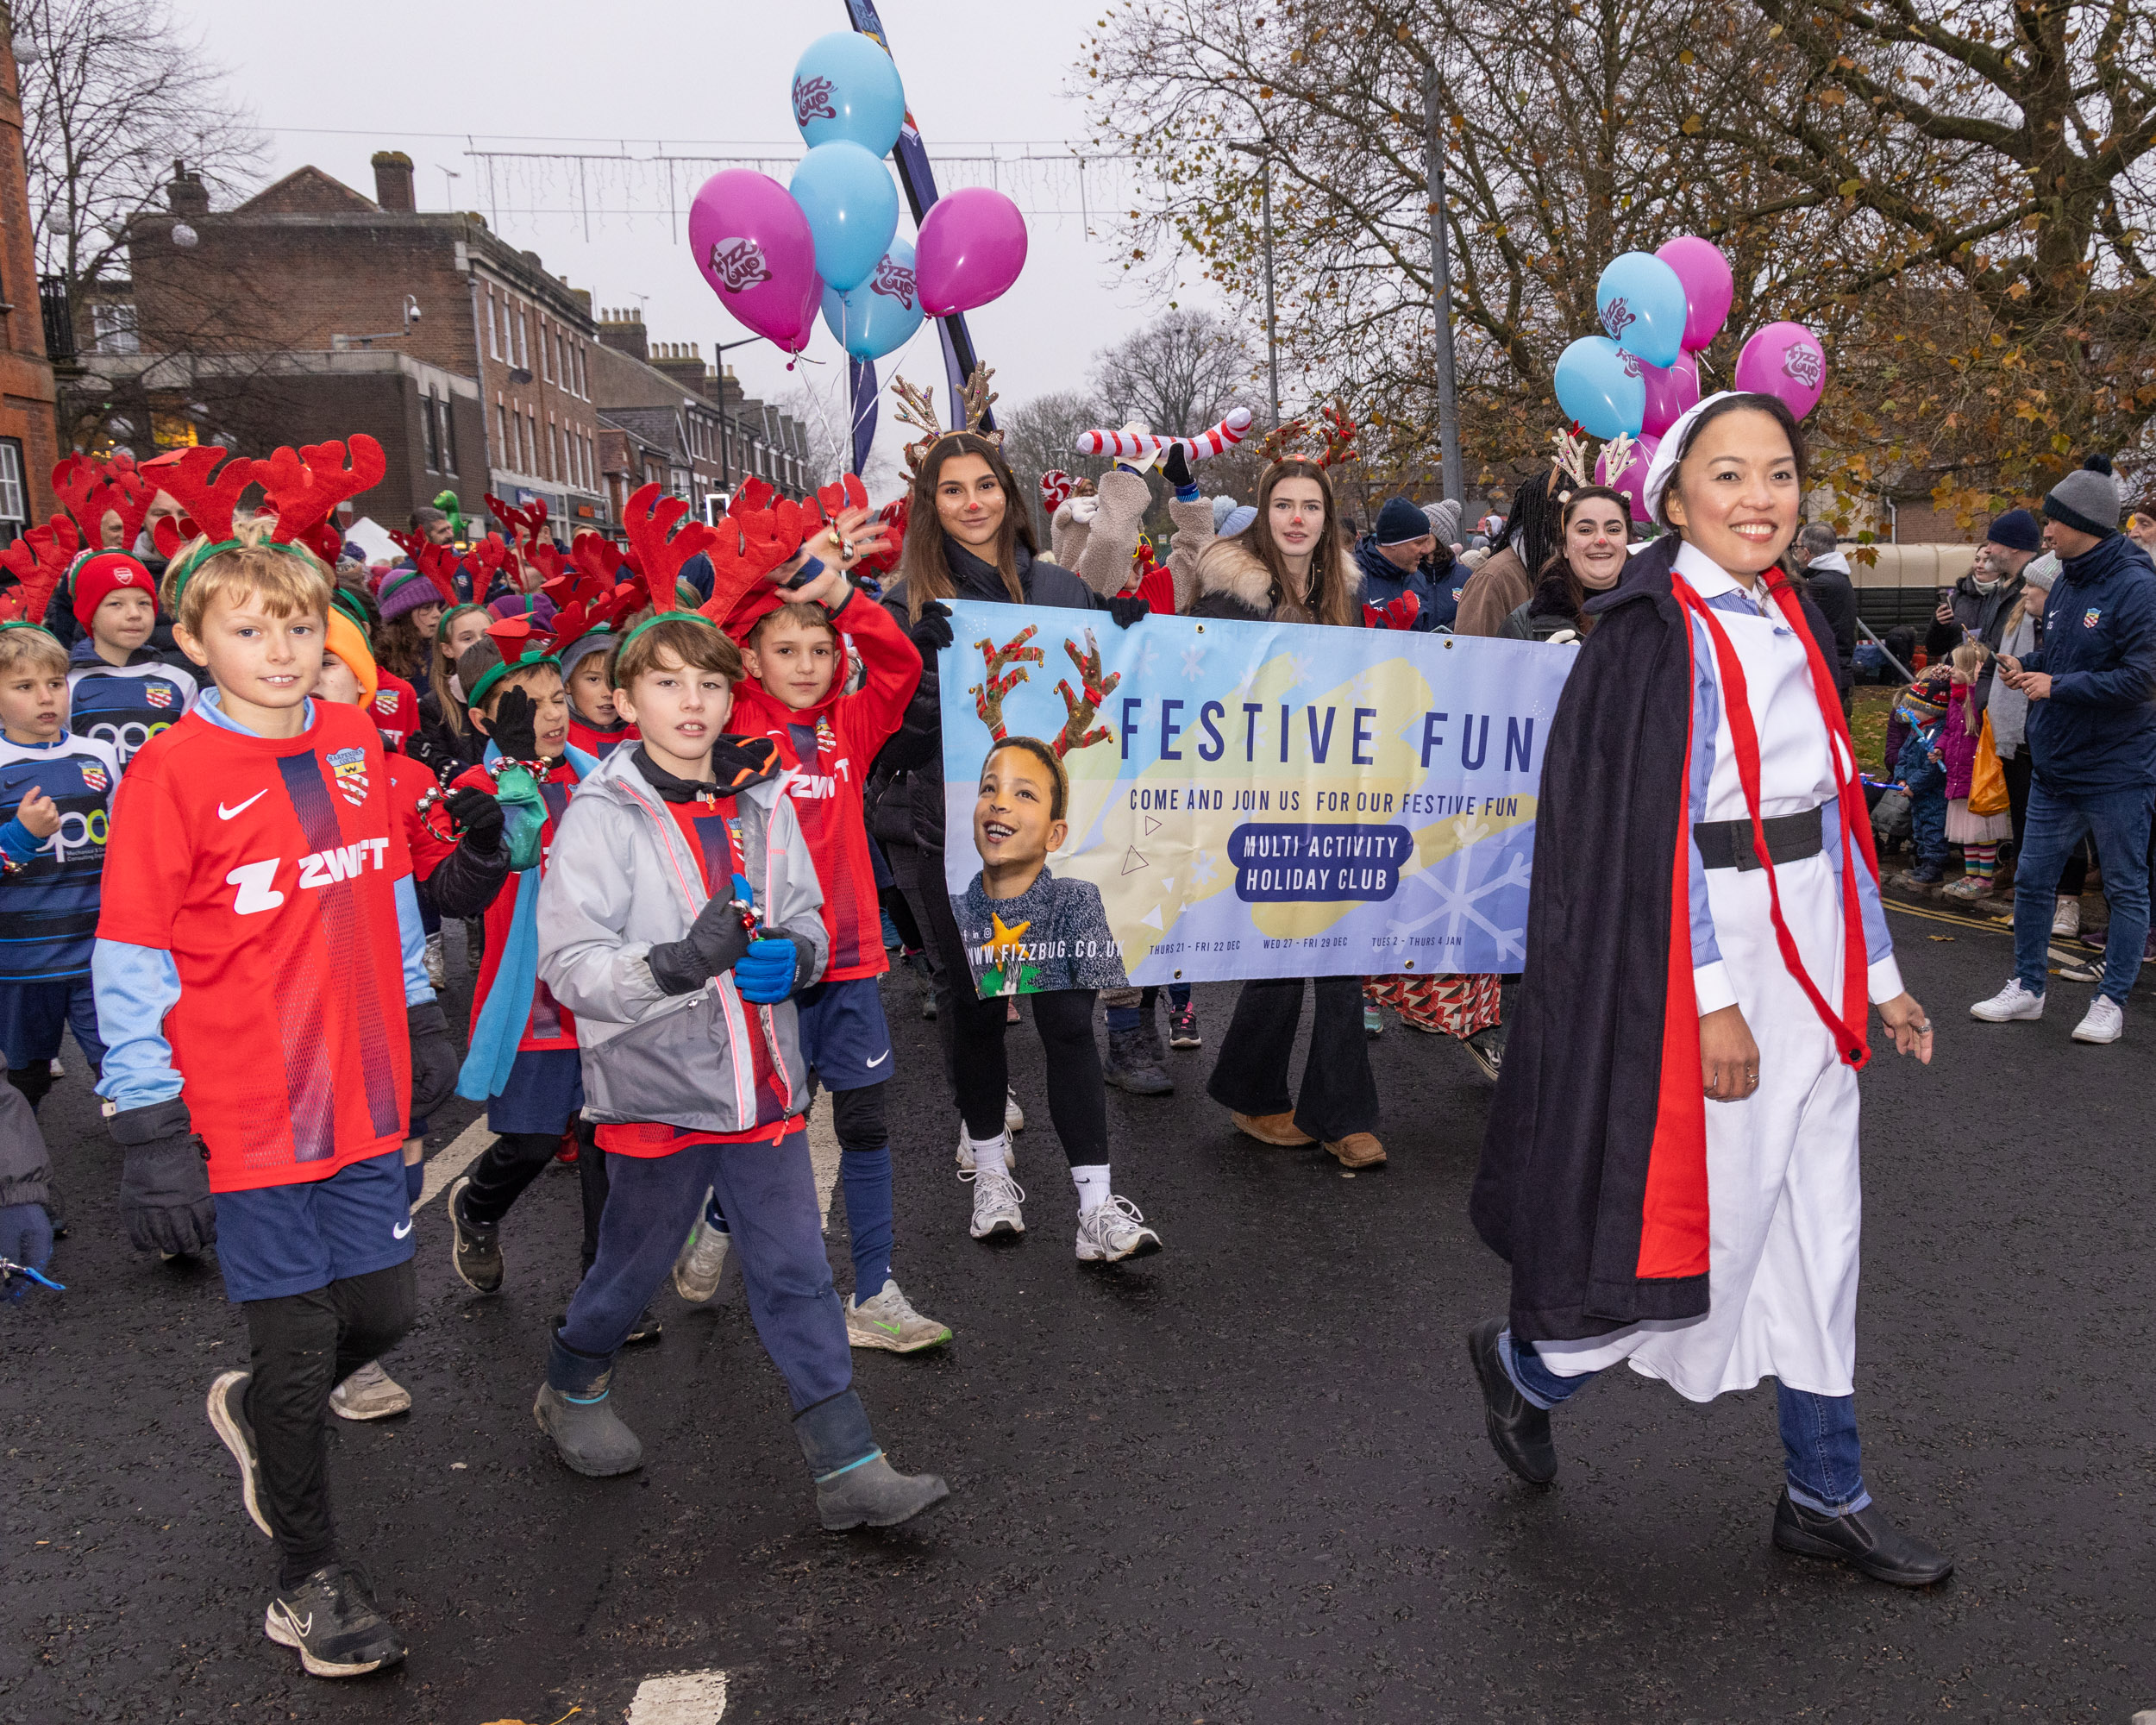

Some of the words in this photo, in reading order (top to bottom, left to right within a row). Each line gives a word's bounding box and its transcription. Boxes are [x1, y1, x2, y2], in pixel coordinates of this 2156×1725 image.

[1121, 698, 1377, 765] FESTIVE
[1420, 712, 1534, 772] FUN
[328, 749, 364, 762] HARPENDEN
[339, 756, 357, 765] COLTS
[1130, 789, 1179, 810] COME
[1187, 789, 1223, 810] AND
[1232, 790, 1269, 810] JOIN
[1279, 791, 1300, 811] US
[1316, 792, 1350, 812] FOR
[1357, 792, 1394, 812] OUR
[1402, 794, 1476, 815] FESTIVE
[1484, 797, 1518, 817] FUN
[1243, 835, 1299, 857] MULTI
[1308, 836, 1398, 858] ACTIVITY
[298, 837, 389, 889] ZWIFT
[1246, 869, 1330, 890] HOLIDAY
[1338, 868, 1387, 890] CLUB
[1150, 944, 1174, 955] THURS
[1176, 943, 1184, 952] 21
[1195, 941, 1210, 951] FRI
[1213, 941, 1224, 951] 22
[1227, 940, 1240, 950] DEC
[1263, 939, 1280, 949] WED
[1283, 938, 1292, 948] 27
[1304, 938, 1317, 947] FRI
[1333, 938, 1347, 946] DEC
[1372, 937, 1390, 946] TUES
[1393, 937, 1398, 945] 2
[1410, 937, 1435, 946] THURS
[1438, 937, 1442, 945] 4
[1445, 937, 1462, 946] JAN
